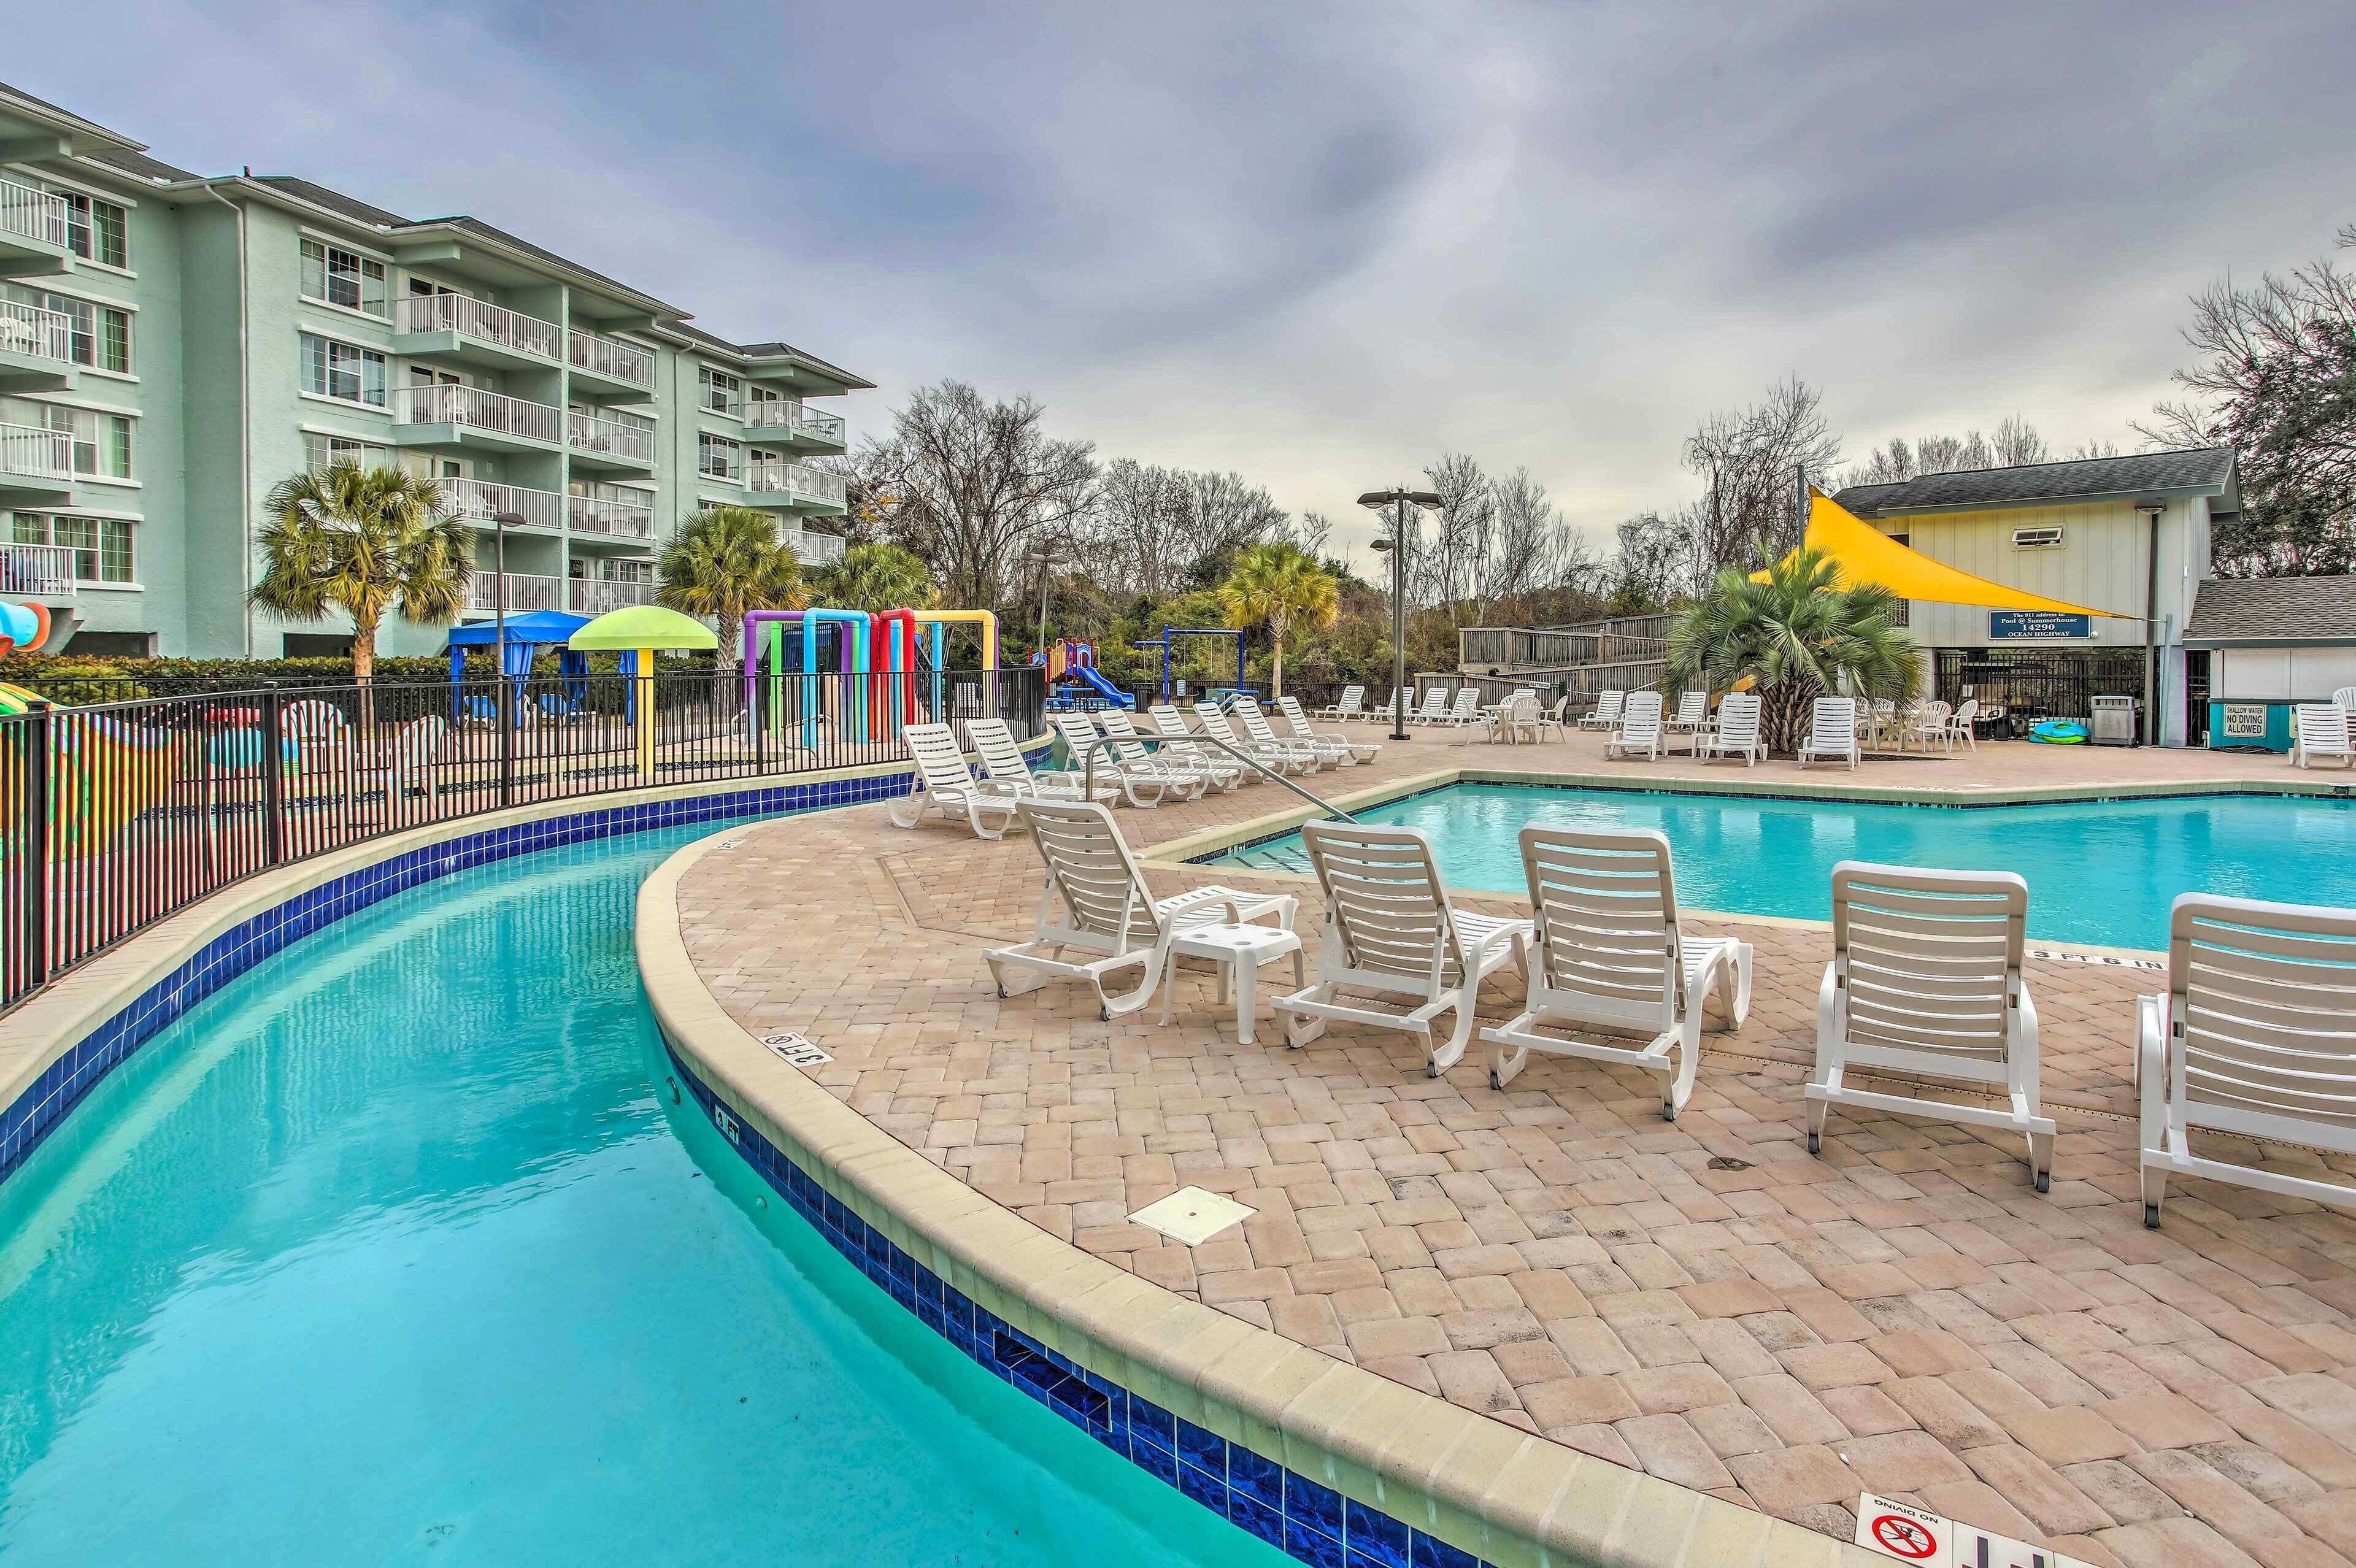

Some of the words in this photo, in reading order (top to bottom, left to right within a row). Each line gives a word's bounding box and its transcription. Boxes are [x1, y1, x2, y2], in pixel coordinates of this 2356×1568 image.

[2227, 714, 2236, 723] NO
[2239, 715, 2263, 724] DIVING
[2227, 724, 2262, 734] ALLOWED
[2134, 961, 2164, 970] IN
[776, 1043, 814, 1056] FT
[795, 1055, 824, 1063] 3
[717, 1111, 723, 1128] 3
[727, 1118, 739, 1142] FT
[1874, 1499, 1915, 1518] DIVING
[1920, 1513, 1938, 1524] NO
